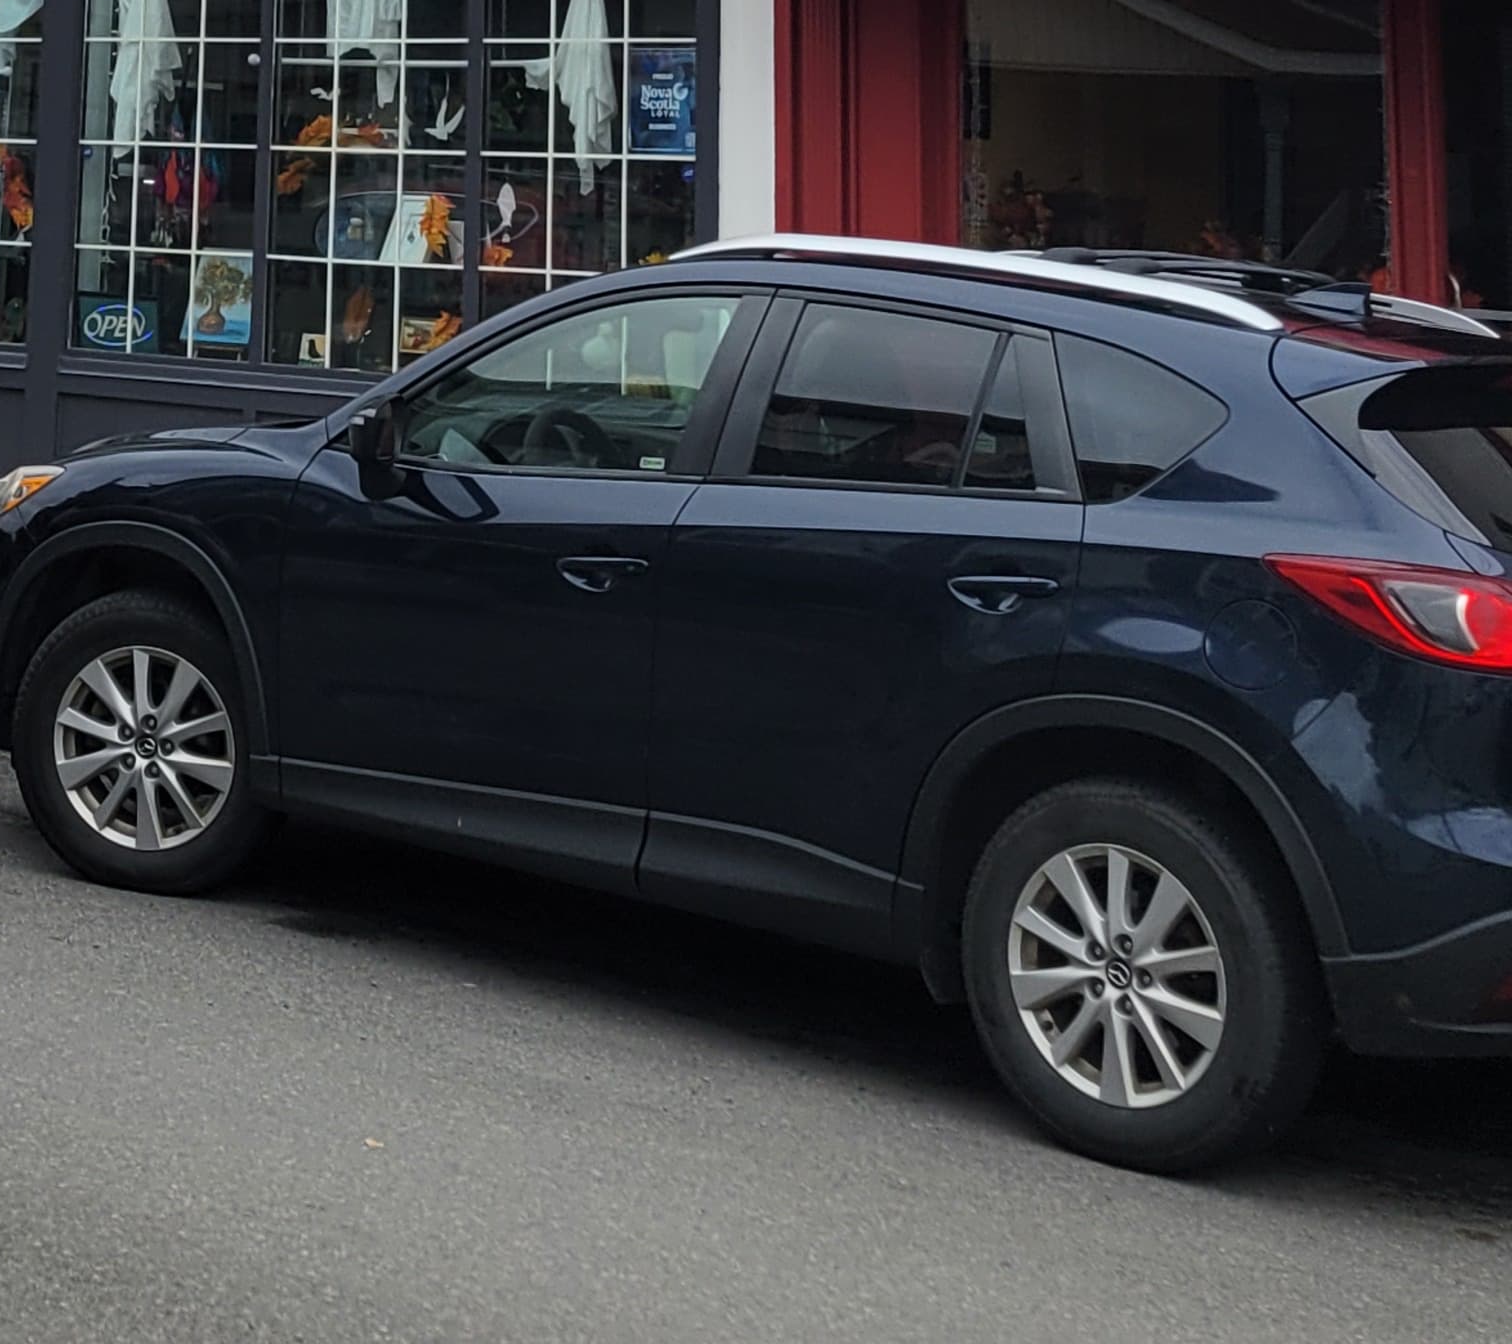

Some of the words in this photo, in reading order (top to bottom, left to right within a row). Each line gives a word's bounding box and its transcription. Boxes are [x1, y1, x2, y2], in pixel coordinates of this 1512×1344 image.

[641, 84, 673, 98] Nova
[640, 96, 680, 110] Scotia
[651, 110, 680, 118] LOYAL
[84, 312, 145, 337] OPEN
